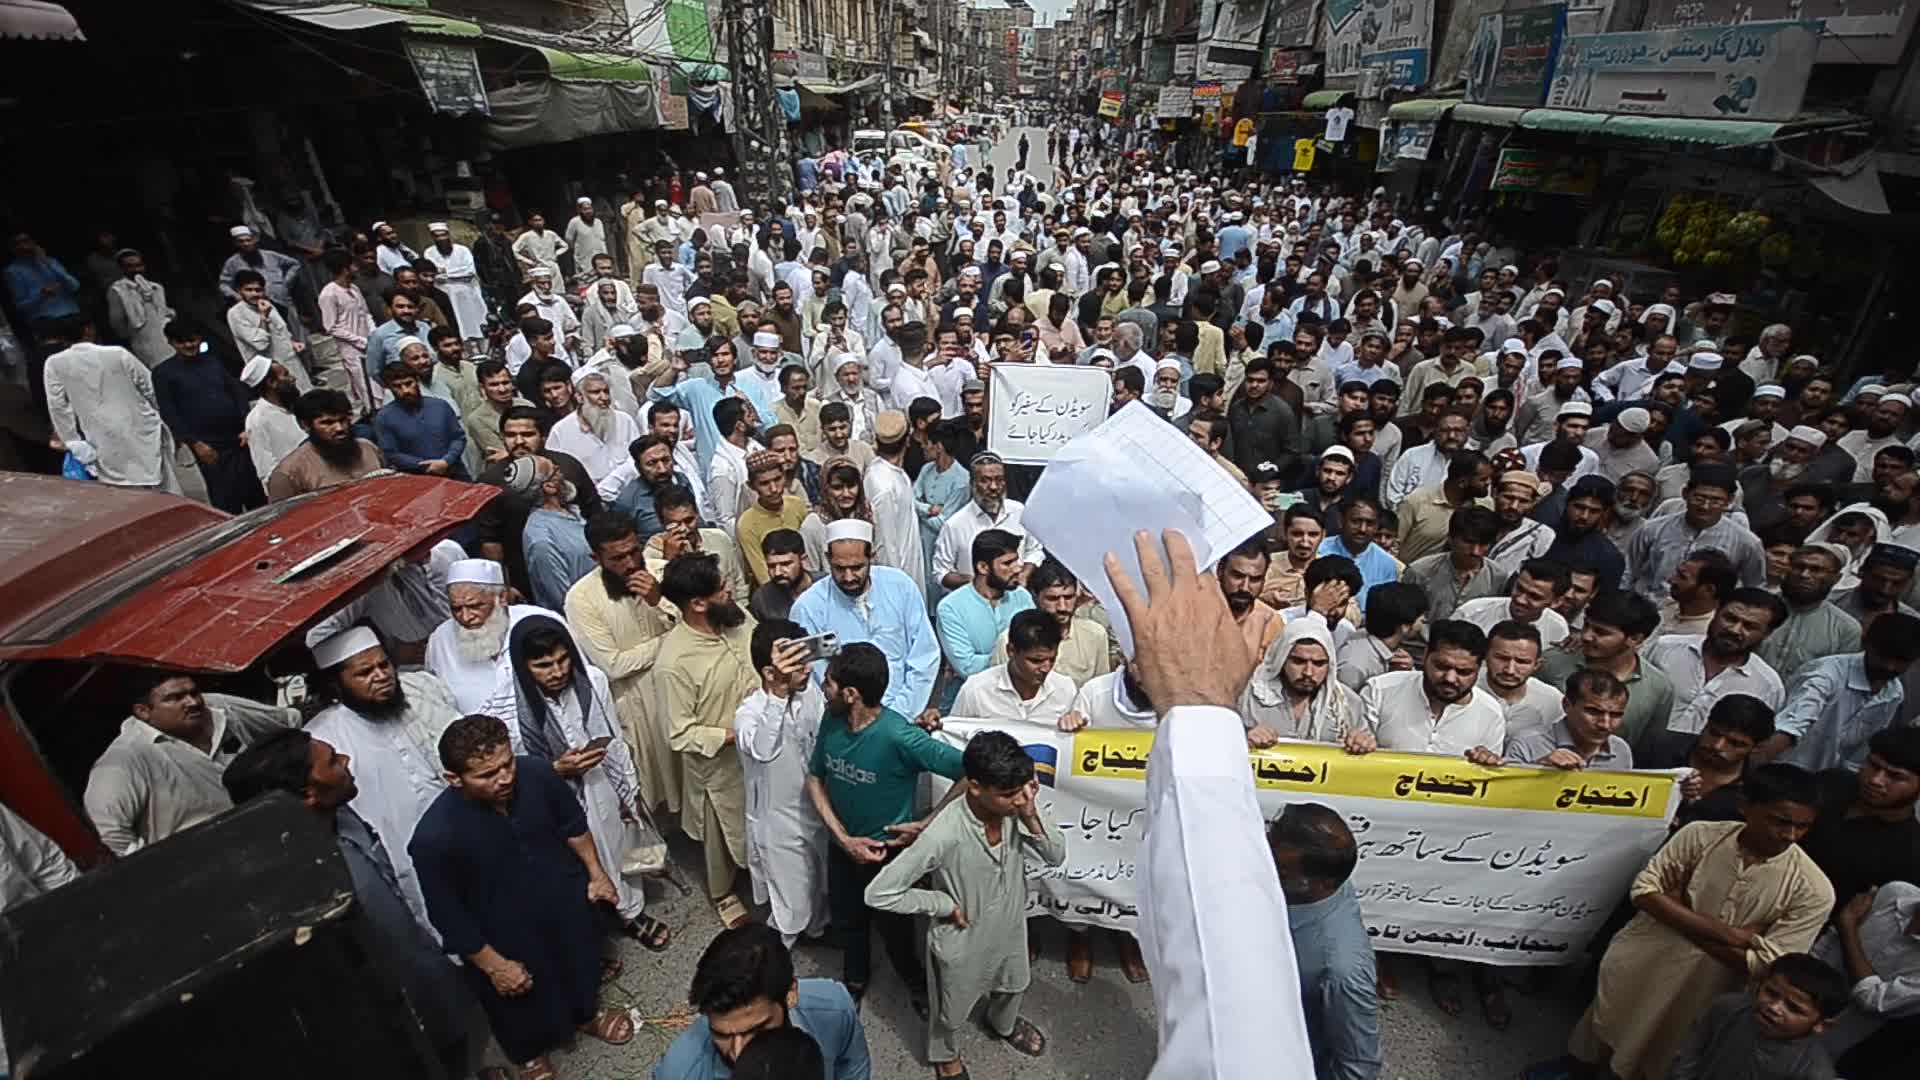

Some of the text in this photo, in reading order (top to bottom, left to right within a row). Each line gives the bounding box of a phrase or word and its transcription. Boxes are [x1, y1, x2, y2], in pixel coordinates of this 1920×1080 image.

[1009, 391, 1092, 418] سویڈن کے سفیر کو
[1008, 424, 1038, 445] جائے
[1040, 420, 1056, 445] کیا
[1082, 744, 1148, 772] تجاج
[1251, 757, 1328, 786] احتجا
[1394, 770, 1489, 799] احتجاج
[1555, 785, 1650, 810] احتجاج
[1107, 806, 1147, 840] کیا
[1375, 831, 1446, 860] ساتھ
[1440, 831, 1493, 862] کے
[1490, 839, 1589, 875] سویڈن
[1107, 858, 1136, 881] قابل
[1418, 885, 1442, 903] کے
[1403, 928, 1476, 946] انجمن
